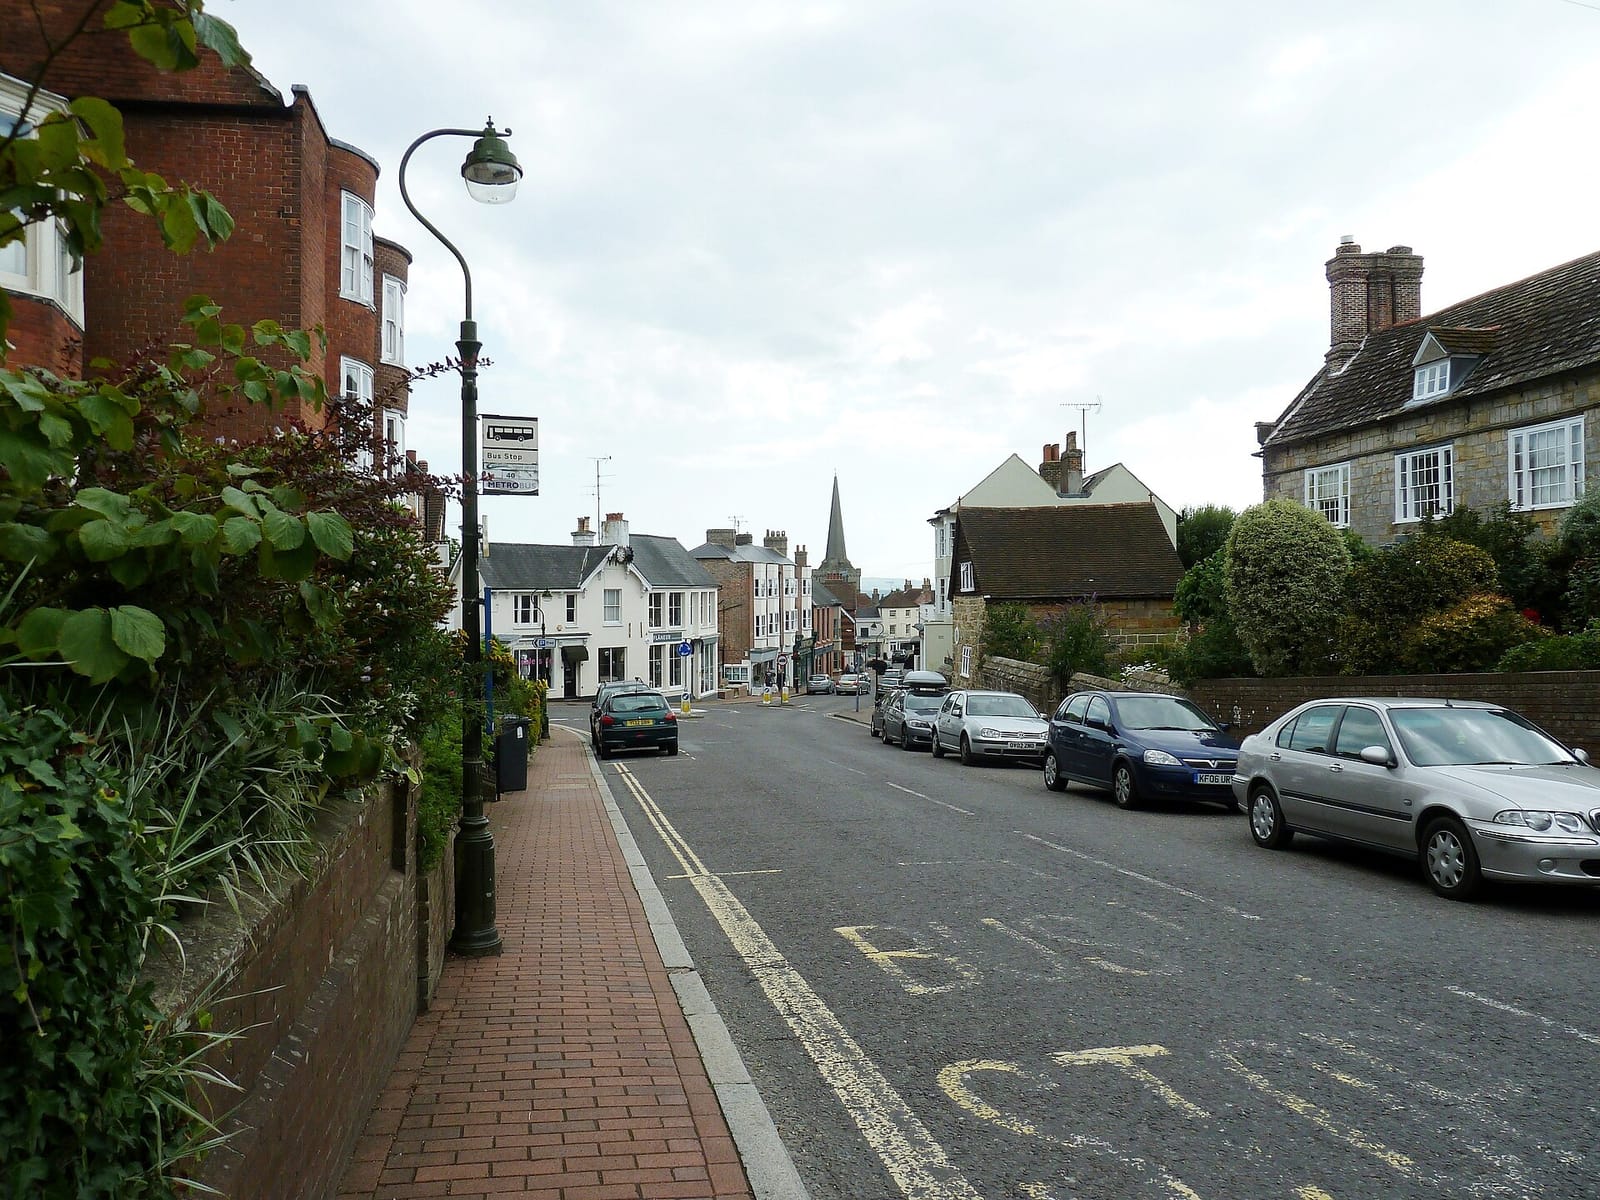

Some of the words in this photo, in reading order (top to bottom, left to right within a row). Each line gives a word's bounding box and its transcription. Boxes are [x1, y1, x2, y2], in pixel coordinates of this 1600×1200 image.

[487, 452, 502, 460] Bus
[504, 453, 523, 461] Stop
[488, 481, 537, 489] METROBUS
[1199, 774, 1220, 783] KF06
